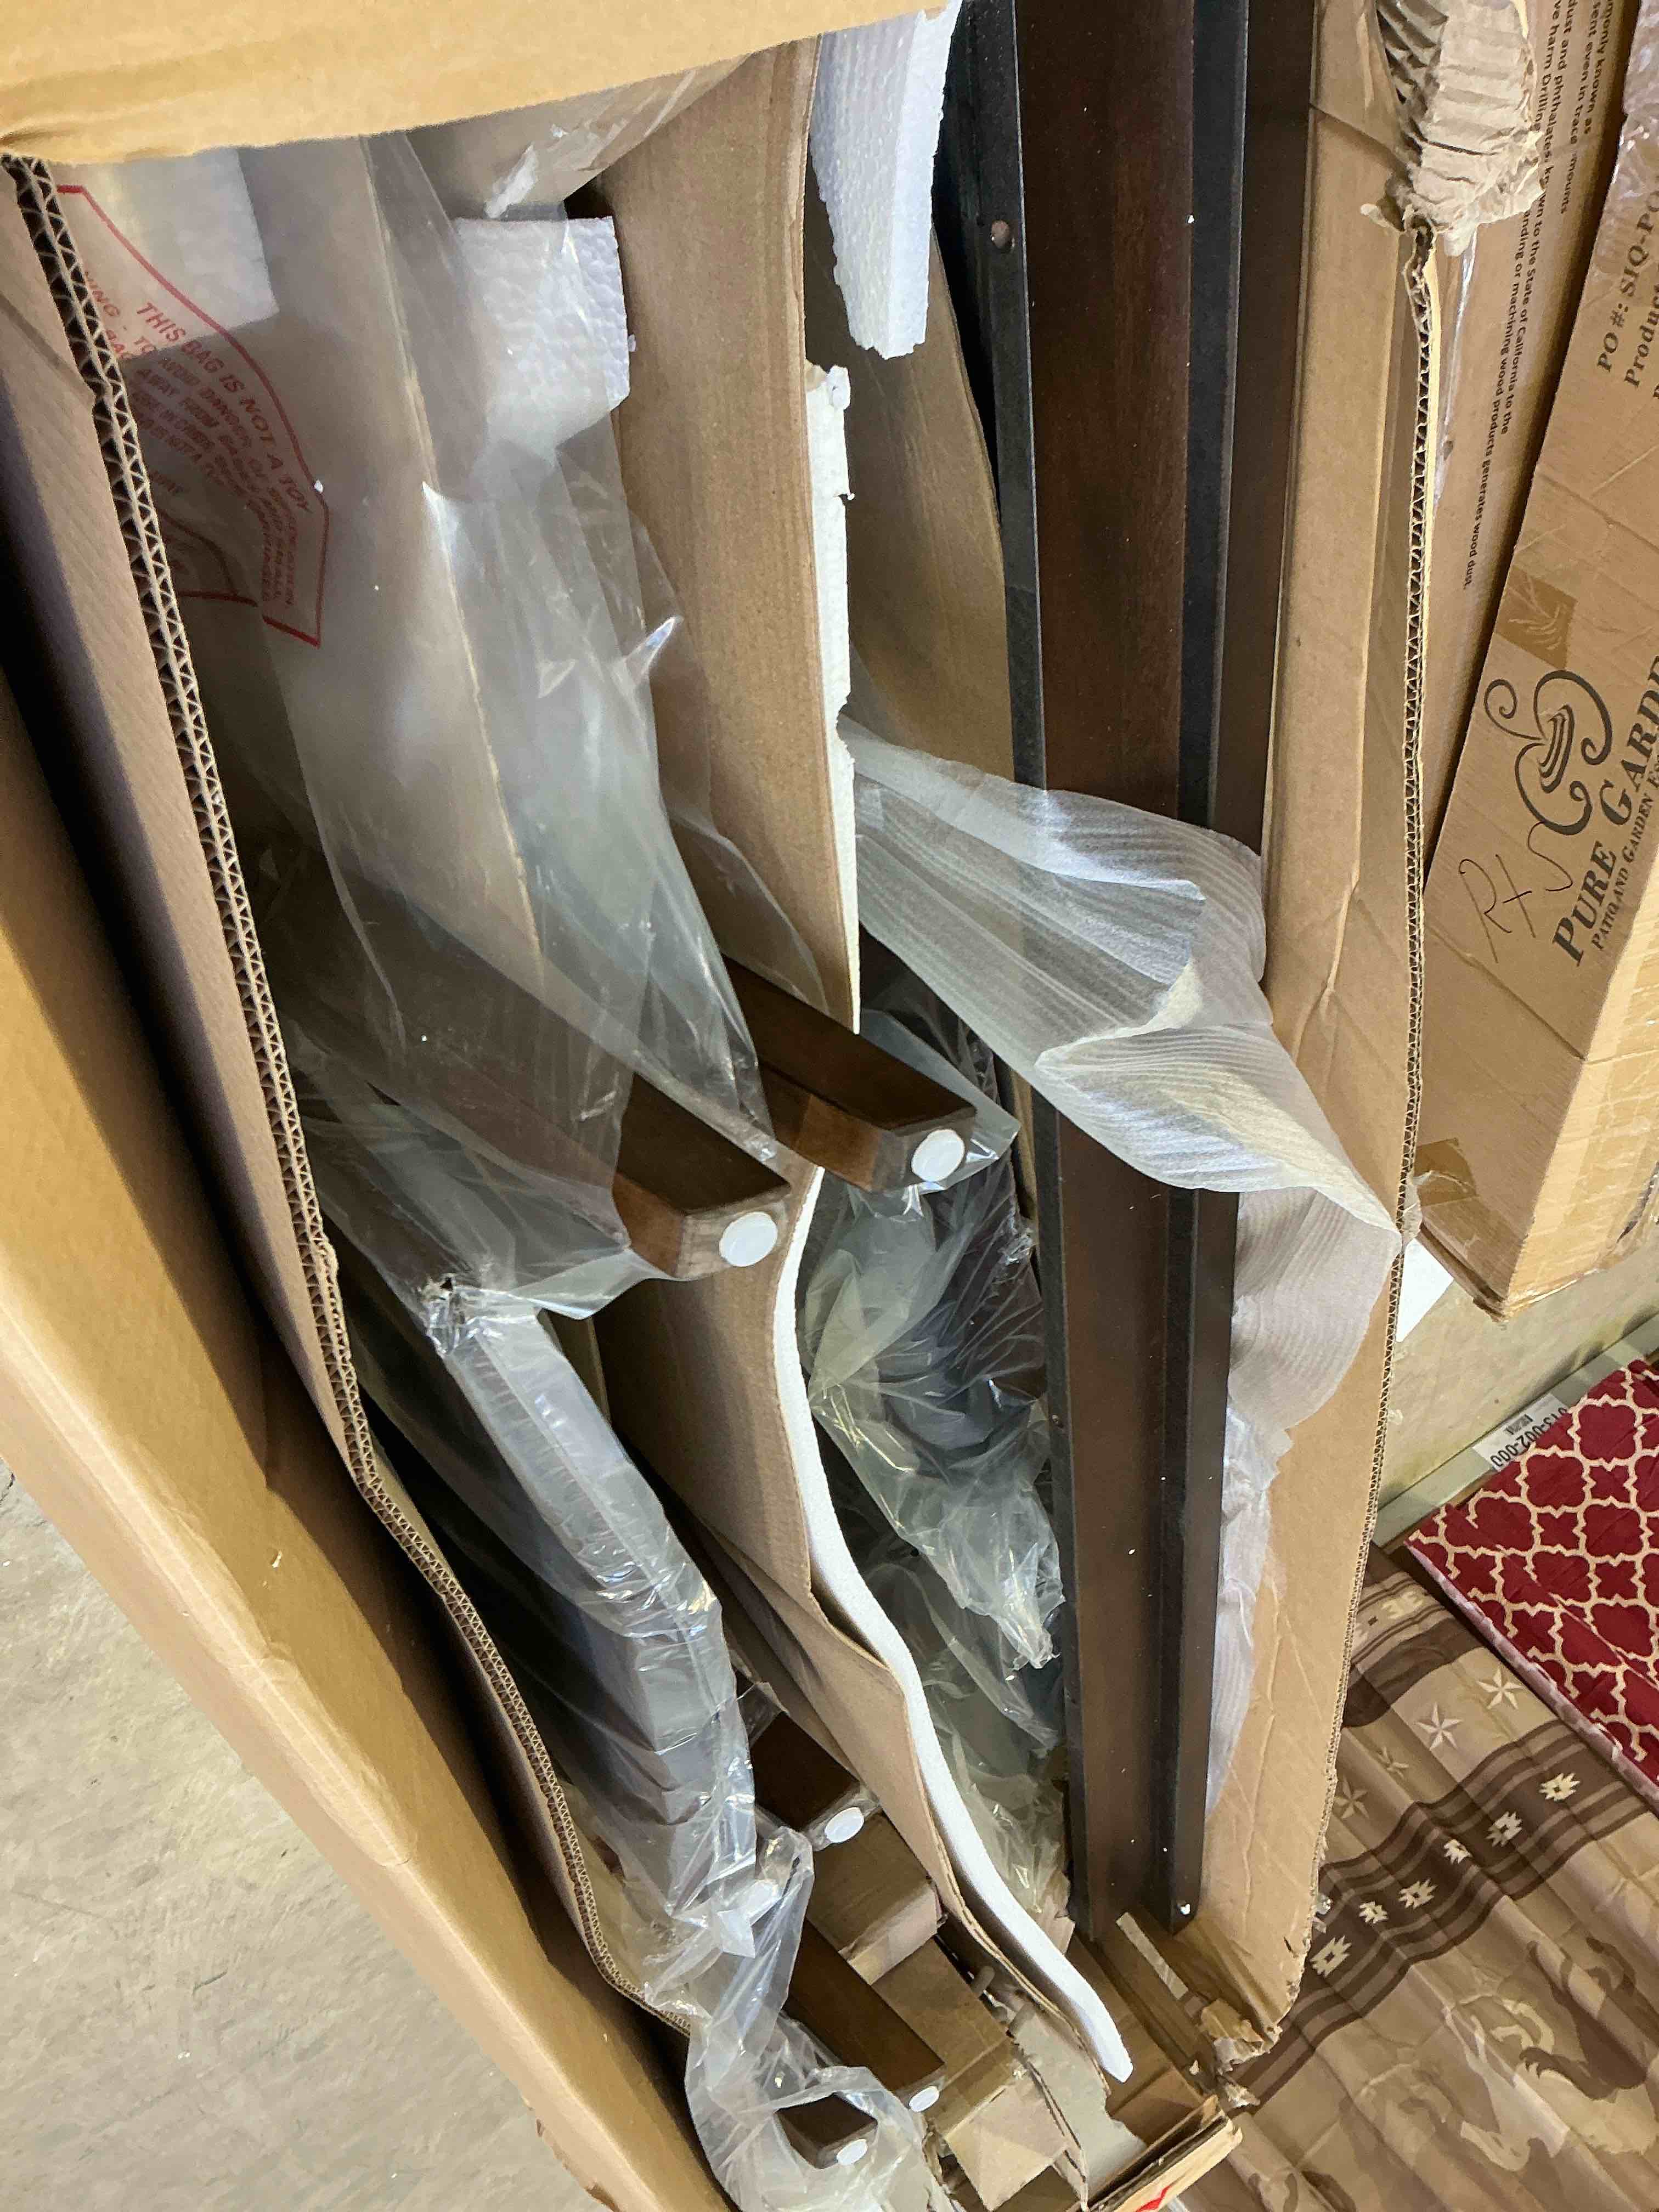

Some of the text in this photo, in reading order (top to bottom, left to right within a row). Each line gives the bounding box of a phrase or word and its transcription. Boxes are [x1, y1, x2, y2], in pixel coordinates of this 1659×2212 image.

[1544, 24, 1560, 70] harm
[1581, 42, 1593, 81] even
[1584, 0, 1613, 134] monly known as
[1578, 85, 1588, 101] in
[1570, 104, 1583, 145] trace
[1501, 0, 1578, 435] dust and phthalates, knwn to the State of California to the
[1514, 263, 1523, 278] or
[1500, 283, 1519, 356] machining
[1597, 332, 1618, 372] PO
[1610, 303, 1628, 328] #:
[1496, 358, 1508, 396] wood
[137, 302, 186, 342] THIS
[181, 340, 224, 373] BAG
[219, 363, 245, 392] IS
[239, 396, 276, 447] NOT
[267, 453, 284, 470] A
[279, 473, 313, 514] TOY
[1486, 399, 1500, 456] products
[1476, 459, 1491, 521] generates
[1469, 523, 1481, 557] wood
[1592, 902, 1619, 950] PATIO
[1613, 867, 1628, 902] AND
[1622, 792, 1654, 863] GARDEN
[1552, 840, 1616, 967] PURE
